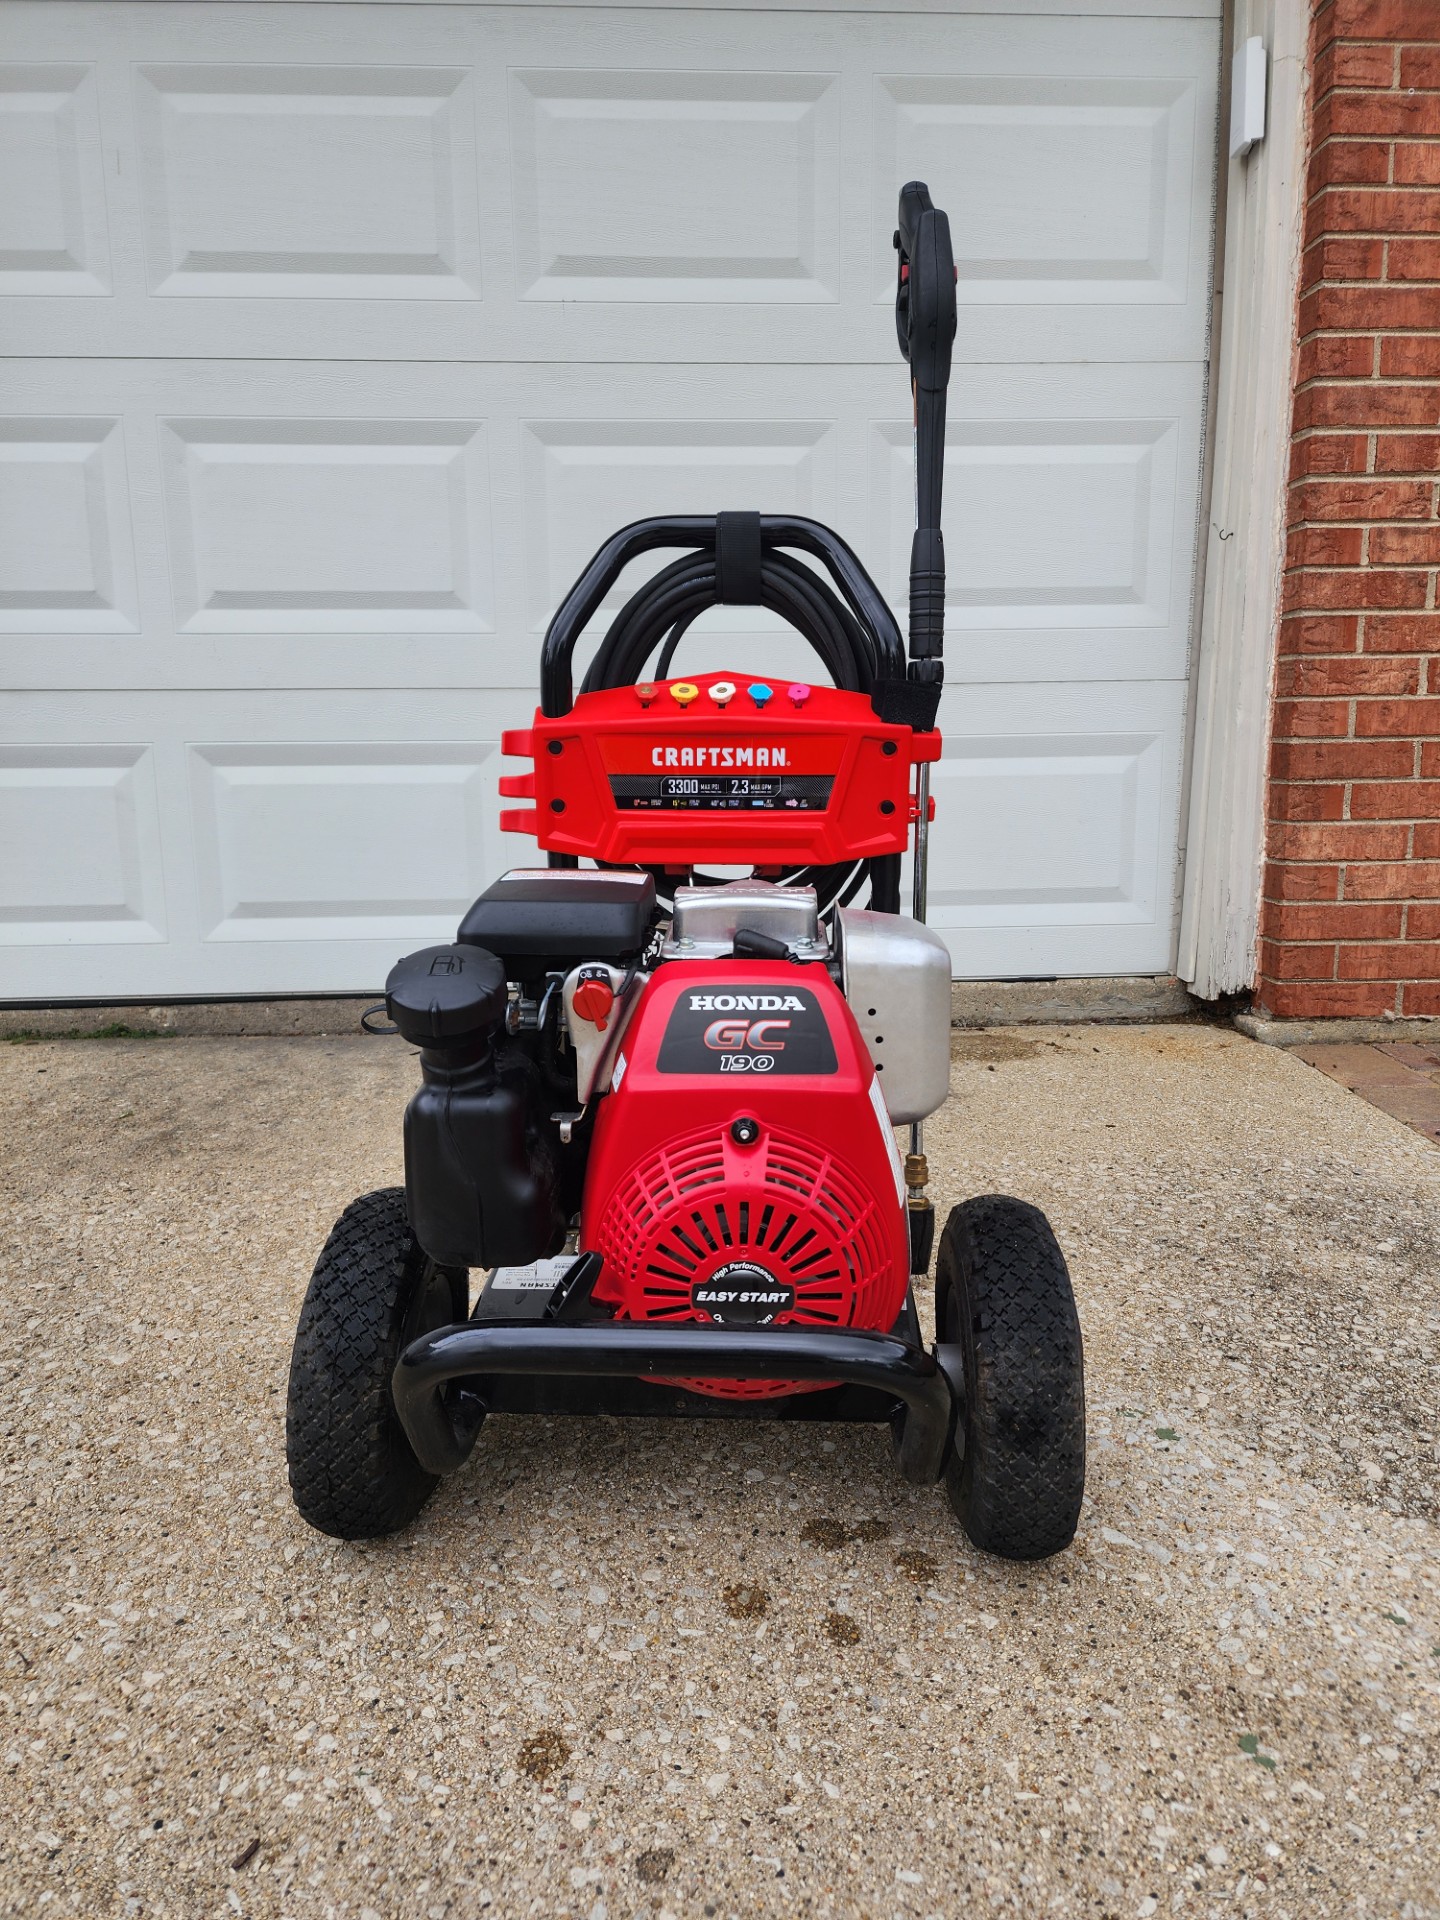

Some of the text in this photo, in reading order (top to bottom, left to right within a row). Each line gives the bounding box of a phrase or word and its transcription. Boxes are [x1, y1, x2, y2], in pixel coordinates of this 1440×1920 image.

[652, 747, 786, 767] CRAFTSMAN
[668, 779, 699, 794] 3300
[731, 779, 749, 794] 2.3
[689, 995, 806, 1011] HONDA
[703, 1019, 792, 1050] GC
[720, 1055, 774, 1072] 190
[712, 1262, 775, 1283] High Performance
[696, 1291, 790, 1303] EASY START
